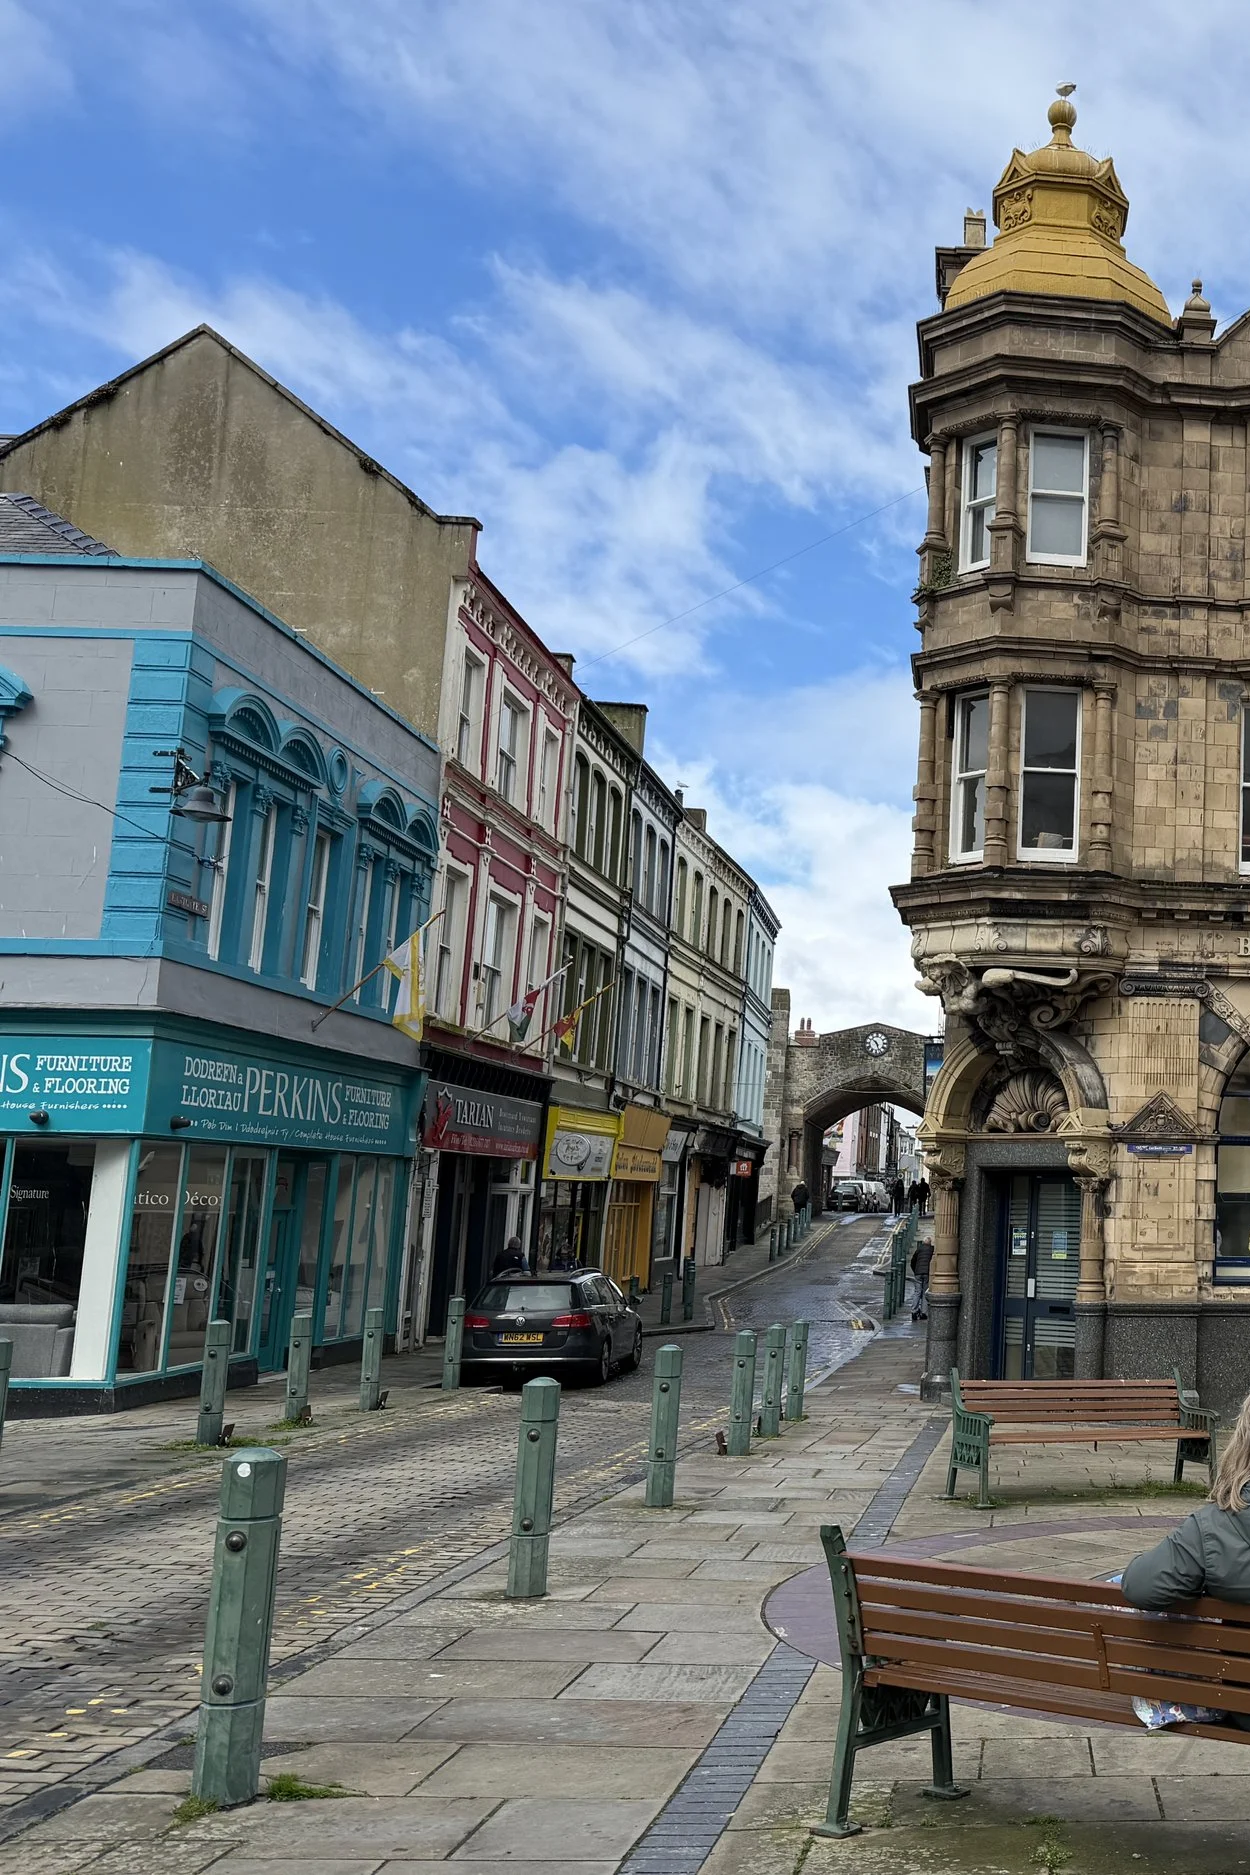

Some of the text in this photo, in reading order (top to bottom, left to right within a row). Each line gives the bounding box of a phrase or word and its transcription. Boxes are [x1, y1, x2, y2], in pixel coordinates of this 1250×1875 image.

[35, 1055, 133, 1072] FURNITURE
[184, 1056, 238, 1084] DODREFN
[32, 1077, 130, 1094] & FLOORING
[243, 1066, 343, 1124] PERKINS
[345, 1085, 392, 1108] FURNITURE
[0, 1100, 100, 1110] House Furnishers
[181, 1085, 242, 1112] LLORIAU
[347, 1109, 390, 1130] FLOORING
[455, 1099, 495, 1128] TARIAN
[201, 1119, 217, 1130] Pob
[294, 1128, 322, 1143] Complete
[324, 1132, 343, 1142] House
[10, 1185, 50, 1201] Signature
[134, 1191, 169, 1205] tico
